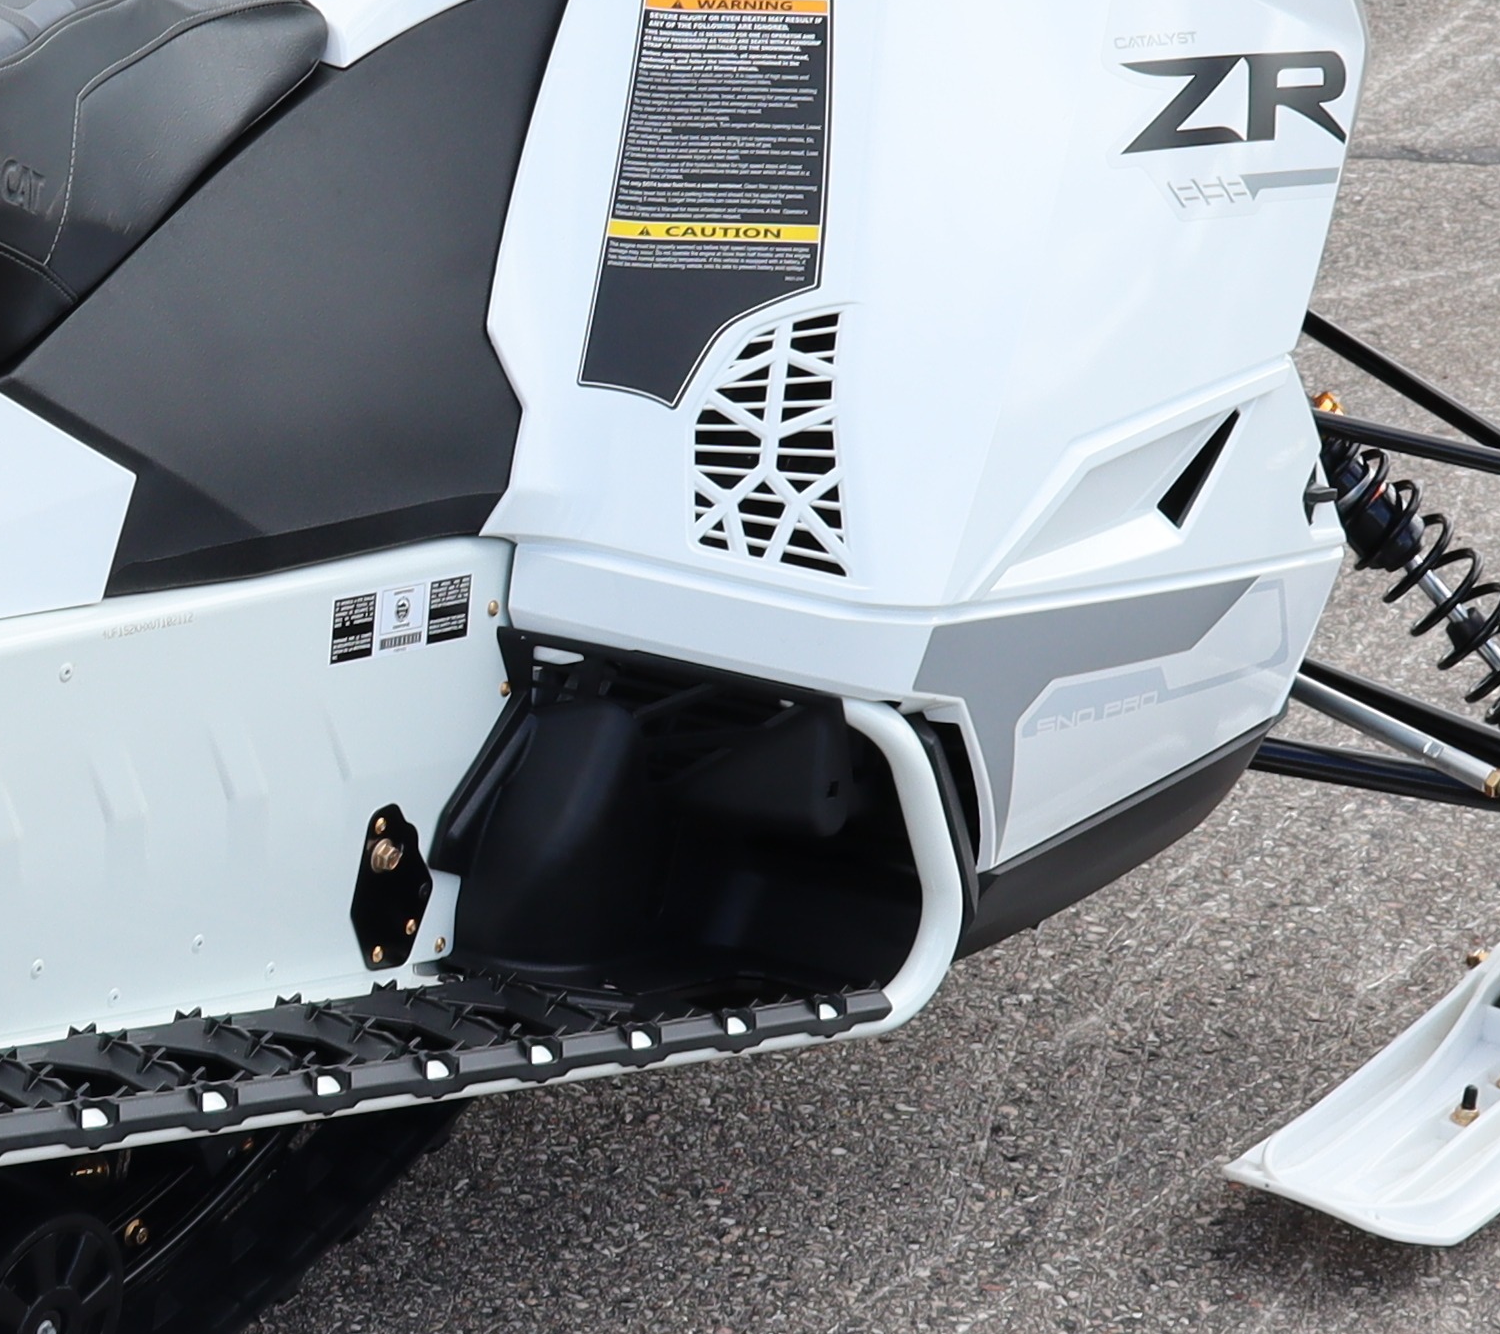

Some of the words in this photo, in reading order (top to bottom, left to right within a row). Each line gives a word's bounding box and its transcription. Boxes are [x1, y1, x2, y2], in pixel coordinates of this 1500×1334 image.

[697, 0, 793, 11] WARNING
[1113, 30, 1197, 50] CATALYST
[1119, 50, 1348, 156] ZR
[0, 156, 48, 215] CAT
[665, 225, 782, 239] CAUTION
